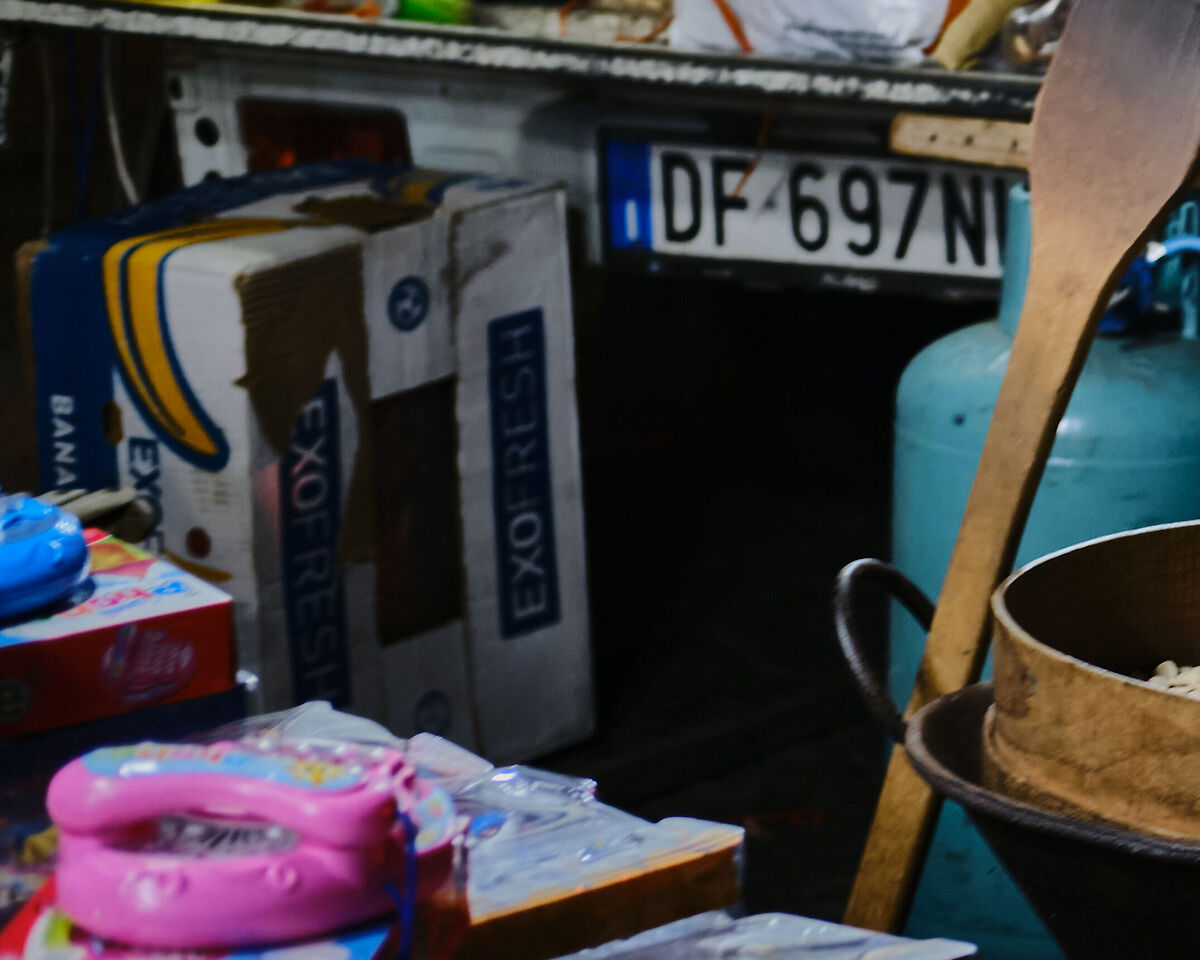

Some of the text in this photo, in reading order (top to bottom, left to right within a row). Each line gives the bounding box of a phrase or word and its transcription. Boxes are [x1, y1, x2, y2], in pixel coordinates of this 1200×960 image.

[660, 150, 1009, 266] DF 697N
[502, 324, 546, 620] EXOFRESH
